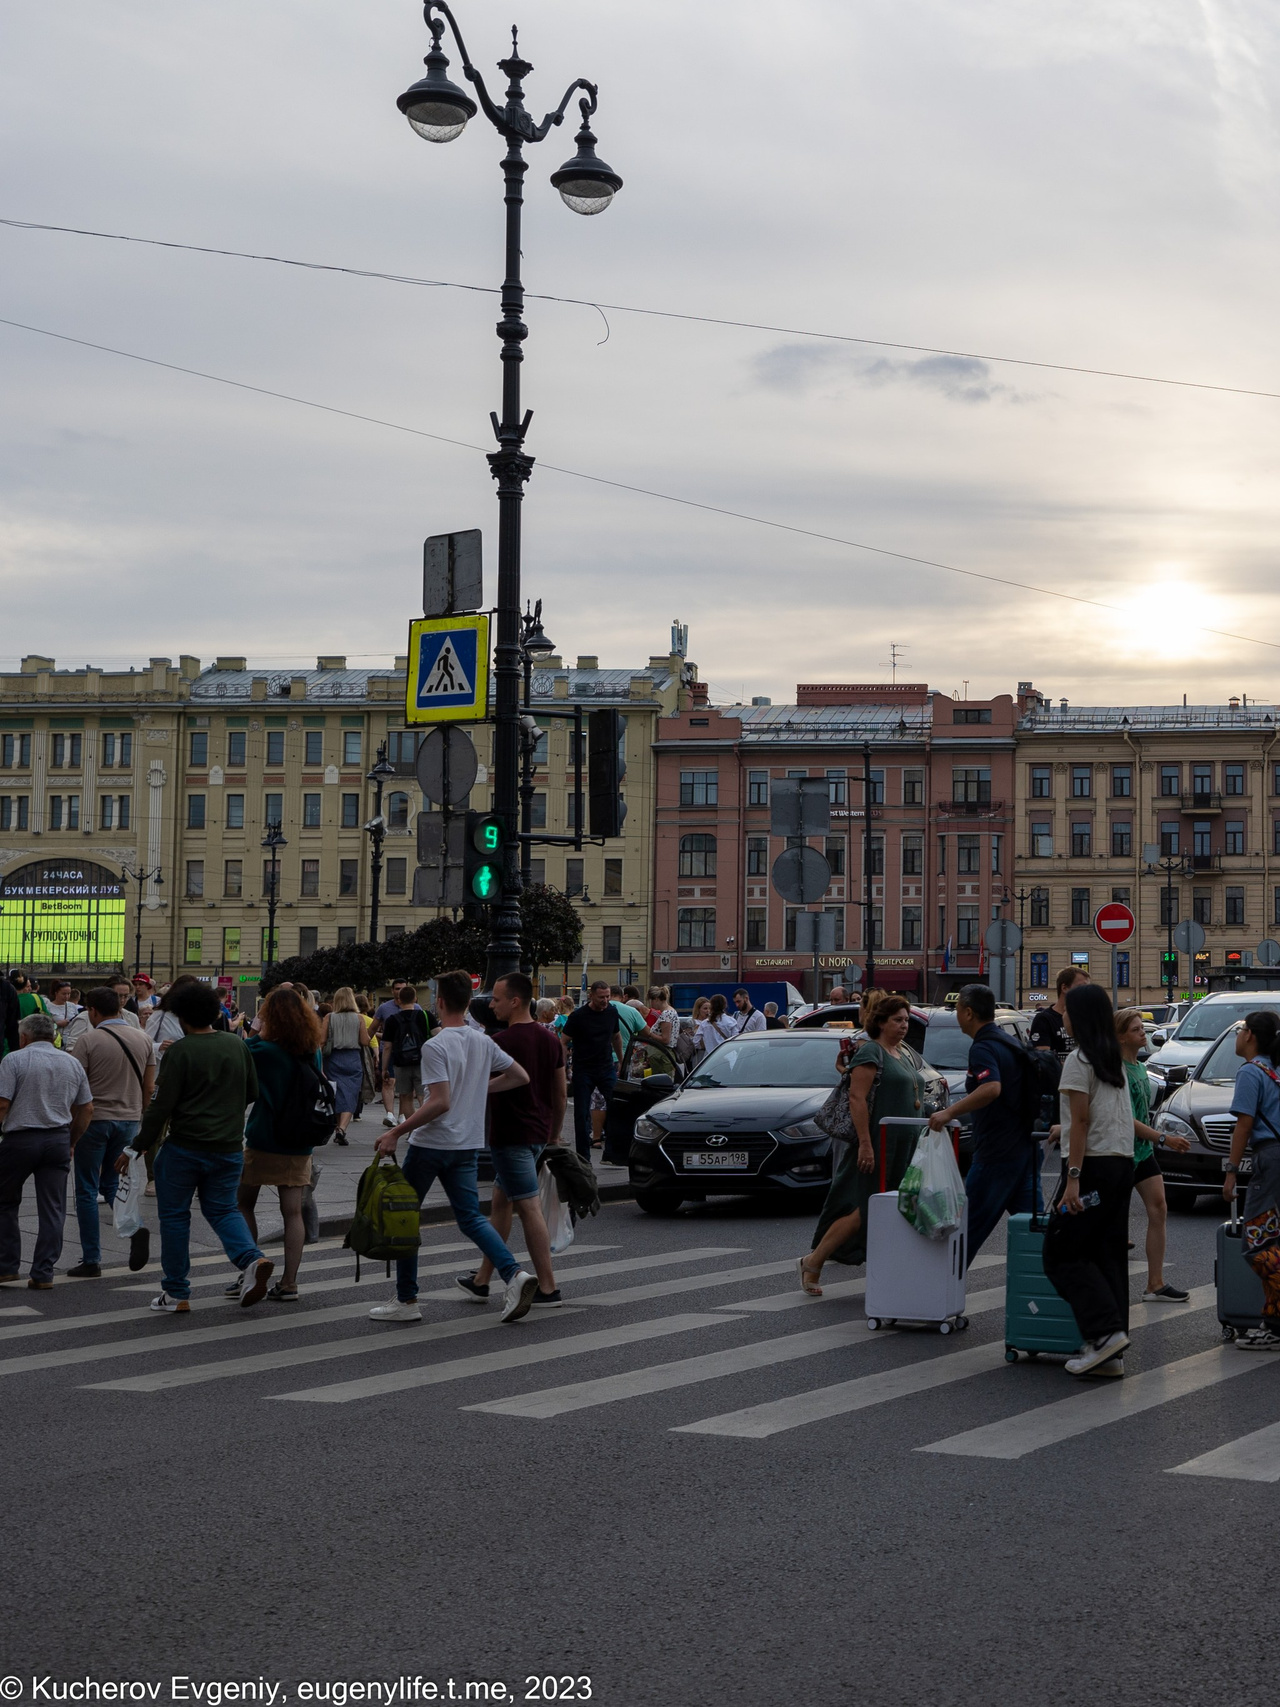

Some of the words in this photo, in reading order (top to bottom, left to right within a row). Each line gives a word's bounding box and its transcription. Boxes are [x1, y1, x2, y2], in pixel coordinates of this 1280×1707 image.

[485, 825, 498, 849] 9
[4, 884, 89, 895] БУКМЕКЕРСКИЙ
[41, 902, 82, 910] BetBoom
[25, 930, 97, 941] КРУГЛОСУТОЧНО
[755, 958, 794, 966] RESTAURANT
[828, 957, 854, 967] NORD
[873, 958, 915, 966] ОНДИТЕРСКАЯ
[1029, 993, 1048, 1001] cofix
[729, 1153, 746, 1162] 198
